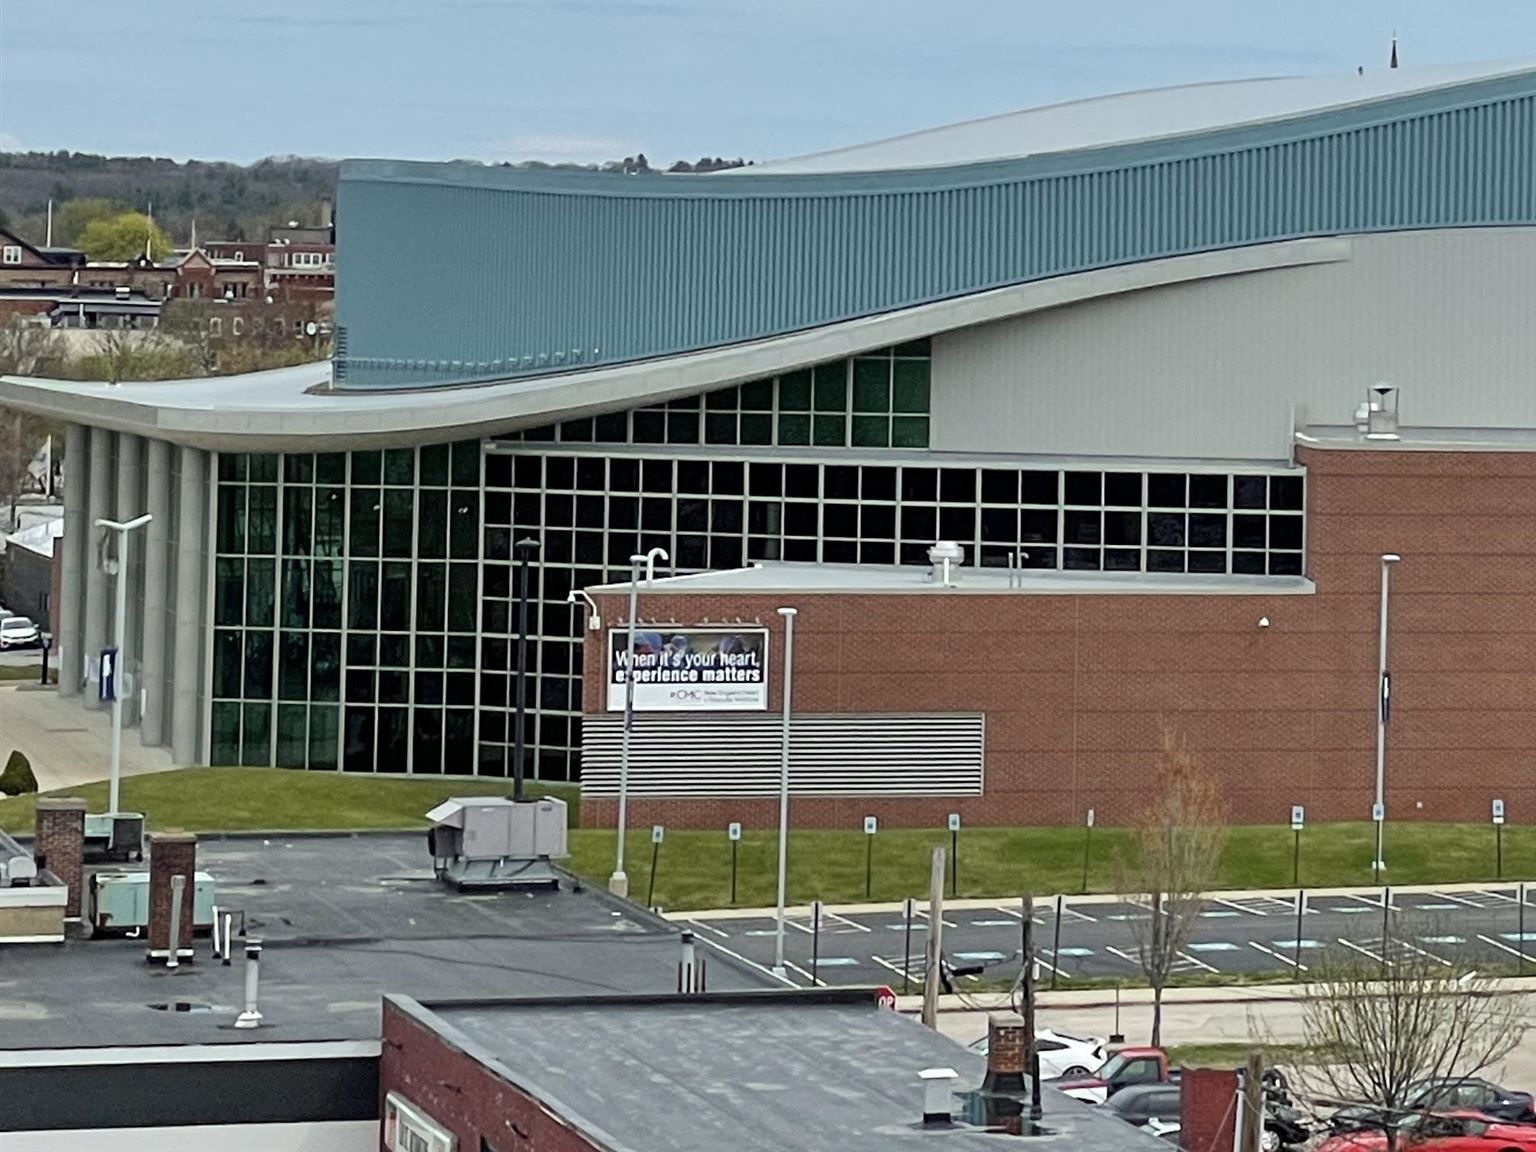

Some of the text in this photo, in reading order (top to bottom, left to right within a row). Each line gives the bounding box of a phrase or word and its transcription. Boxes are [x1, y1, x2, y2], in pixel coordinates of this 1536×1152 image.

[660, 650, 681, 667] it's
[685, 652, 716, 669] your
[720, 651, 760, 667] heart,
[616, 666, 760, 682] eperience matters
